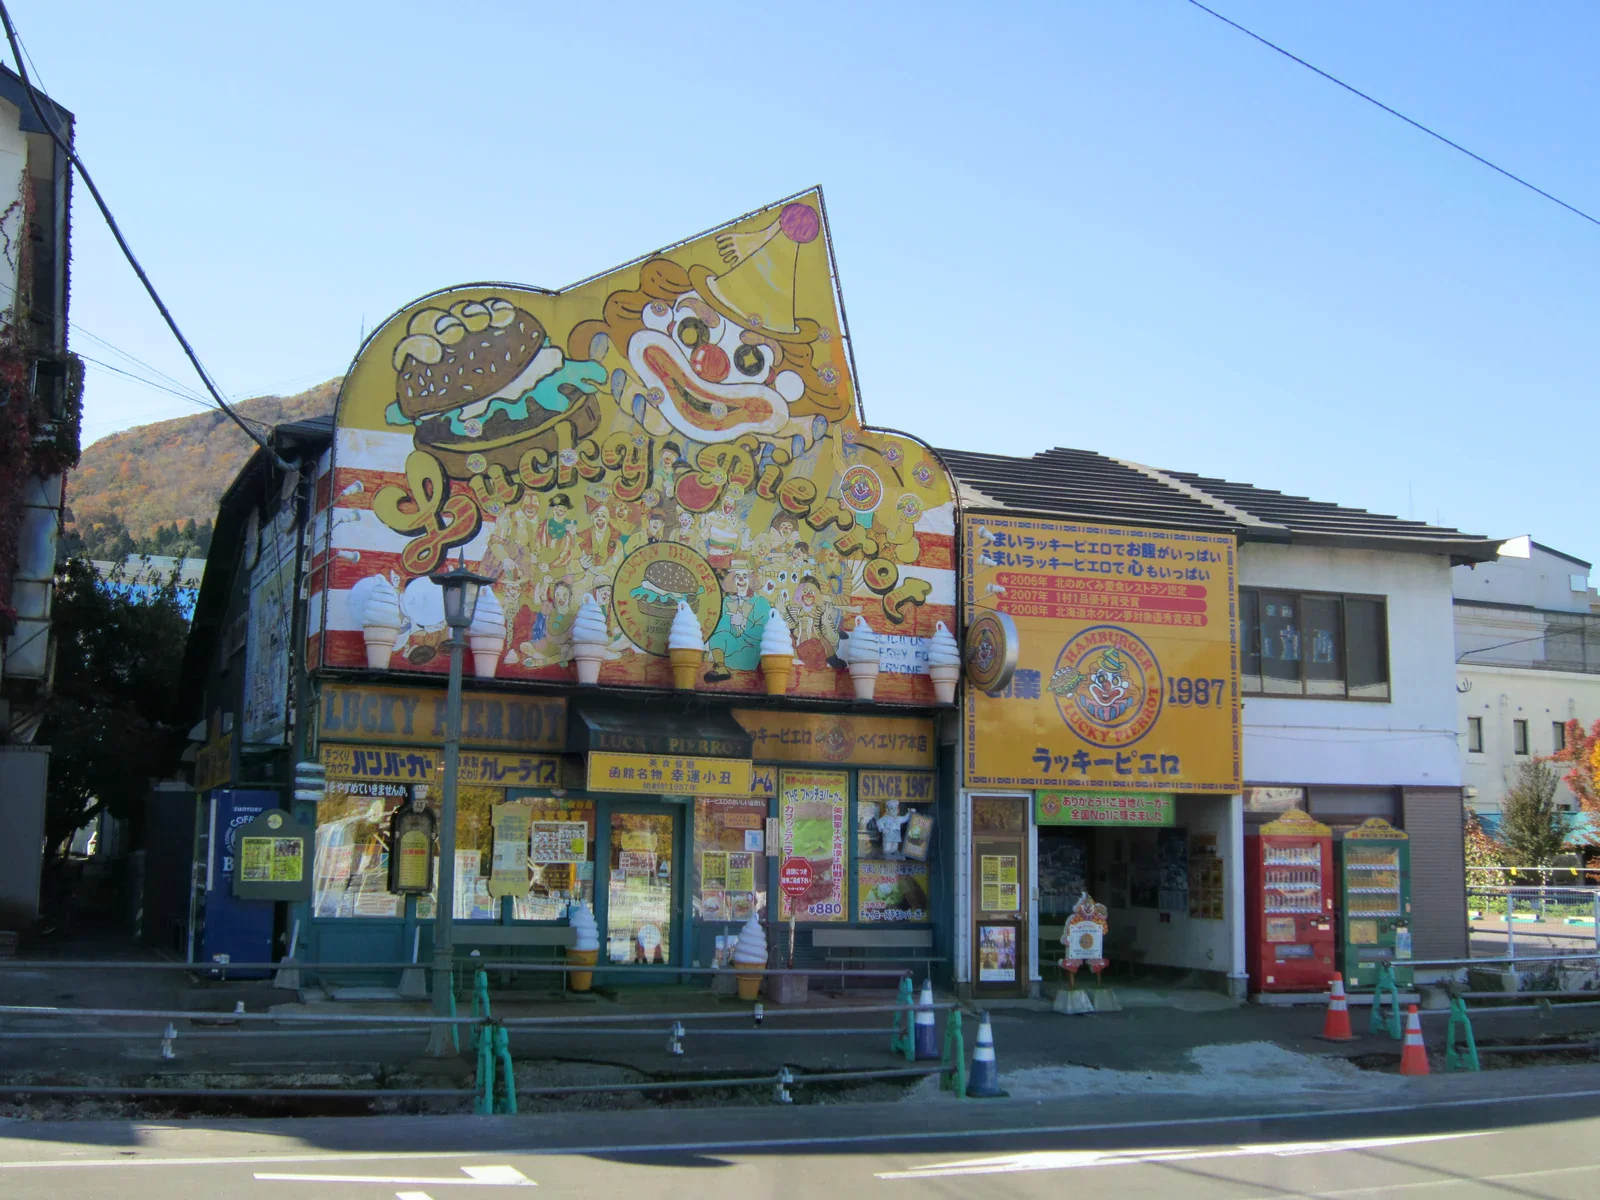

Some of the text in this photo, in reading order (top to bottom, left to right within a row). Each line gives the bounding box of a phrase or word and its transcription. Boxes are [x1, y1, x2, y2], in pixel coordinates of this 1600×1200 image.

[373, 423, 932, 624] Lucky Pierrot
[1010, 575, 1048, 587] 2006年
[1010, 589, 1048, 601] 2007年
[1010, 604, 1048, 616] 2008年
[1065, 631, 1153, 672] HAMBURGER
[1167, 677, 1226, 709] 1987
[322, 690, 564, 743] LUCKY PERROT
[1064, 686, 1159, 743] LUCKY PIERROT
[749, 727, 813, 745] ッキーピエロ
[351, 749, 433, 778] ハンバーガー
[480, 757, 557, 783] カレーライス
[1032, 747, 1180, 775] ラッキーピエロ
[608, 766, 732, 785] 函館名物 幸運小丑
[861, 774, 932, 798] SINCE 1987
[784, 788, 799, 803] THE
[230, 815, 256, 828] COFF
[809, 903, 842, 915] ¥880
